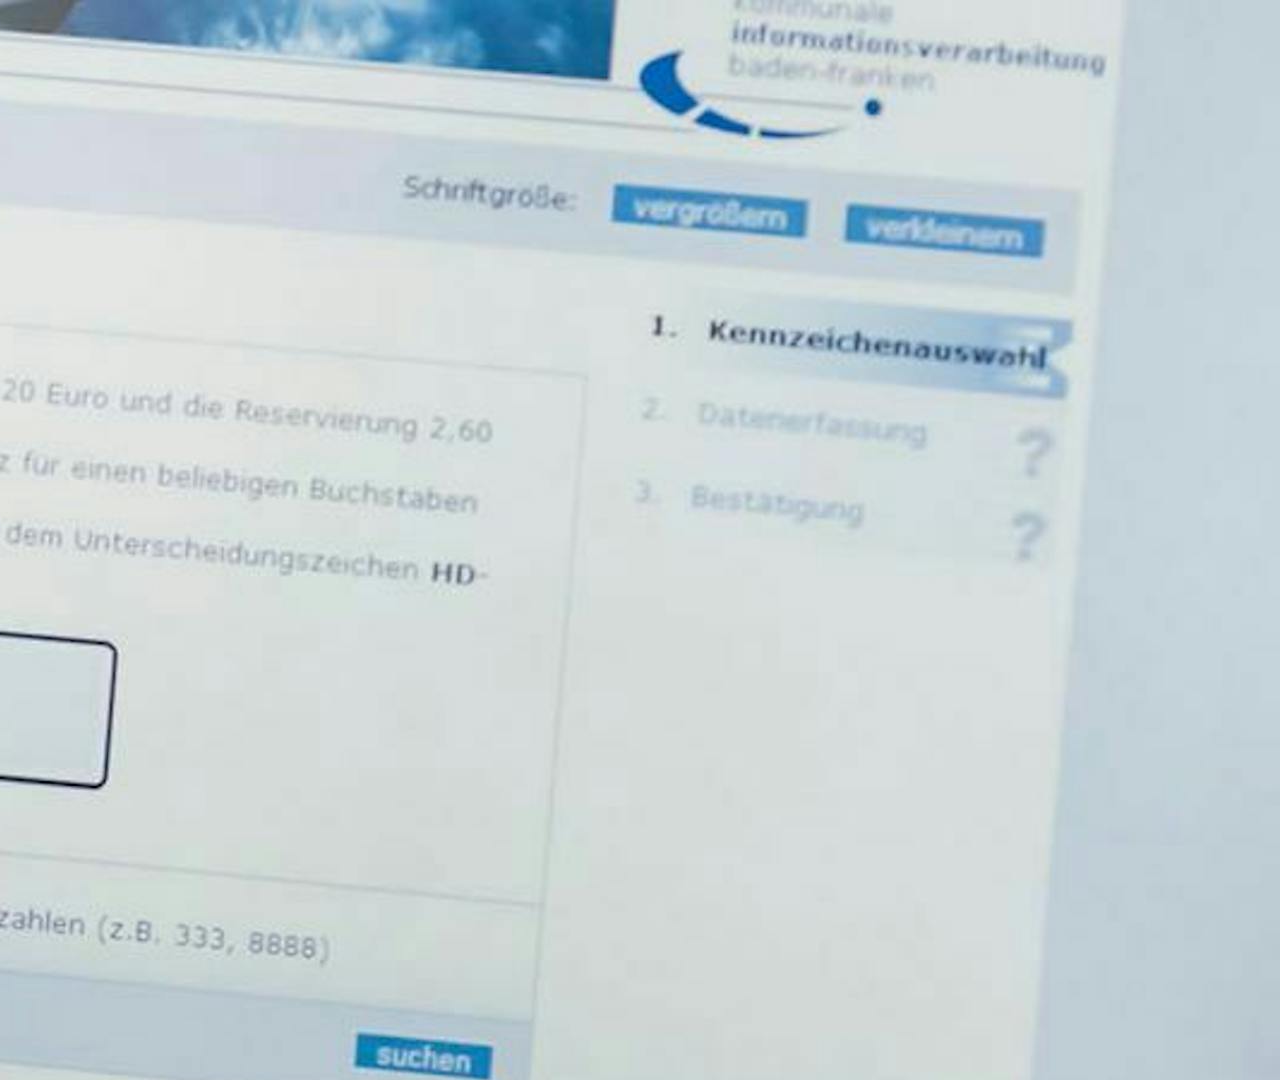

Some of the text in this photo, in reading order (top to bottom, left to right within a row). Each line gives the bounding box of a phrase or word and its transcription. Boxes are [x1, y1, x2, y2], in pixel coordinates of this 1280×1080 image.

[727, 53, 934, 91] baden-franken
[732, 22, 1107, 77] informationsverarbeitung
[650, 315, 1048, 371] 1. Kennzeichenauswahl
[46, 382, 111, 412] Euro
[120, 392, 175, 417] und
[183, 394, 226, 422] die
[235, 398, 420, 445] Reservierung
[429, 416, 495, 446] 2,60
[697, 401, 928, 449] Datenerfassung
[70, 461, 149, 486] einen
[157, 463, 301, 504] beliebigen
[309, 477, 481, 516] Buchstaben
[5, 522, 65, 549] dem
[74, 530, 421, 582] Unterscheidungszeichen
[98, 915, 162, 947] (z.B.
[176, 924, 236, 957] 333,
[247, 931, 330, 967] 8888)
[376, 1044, 471, 1074] suchen
